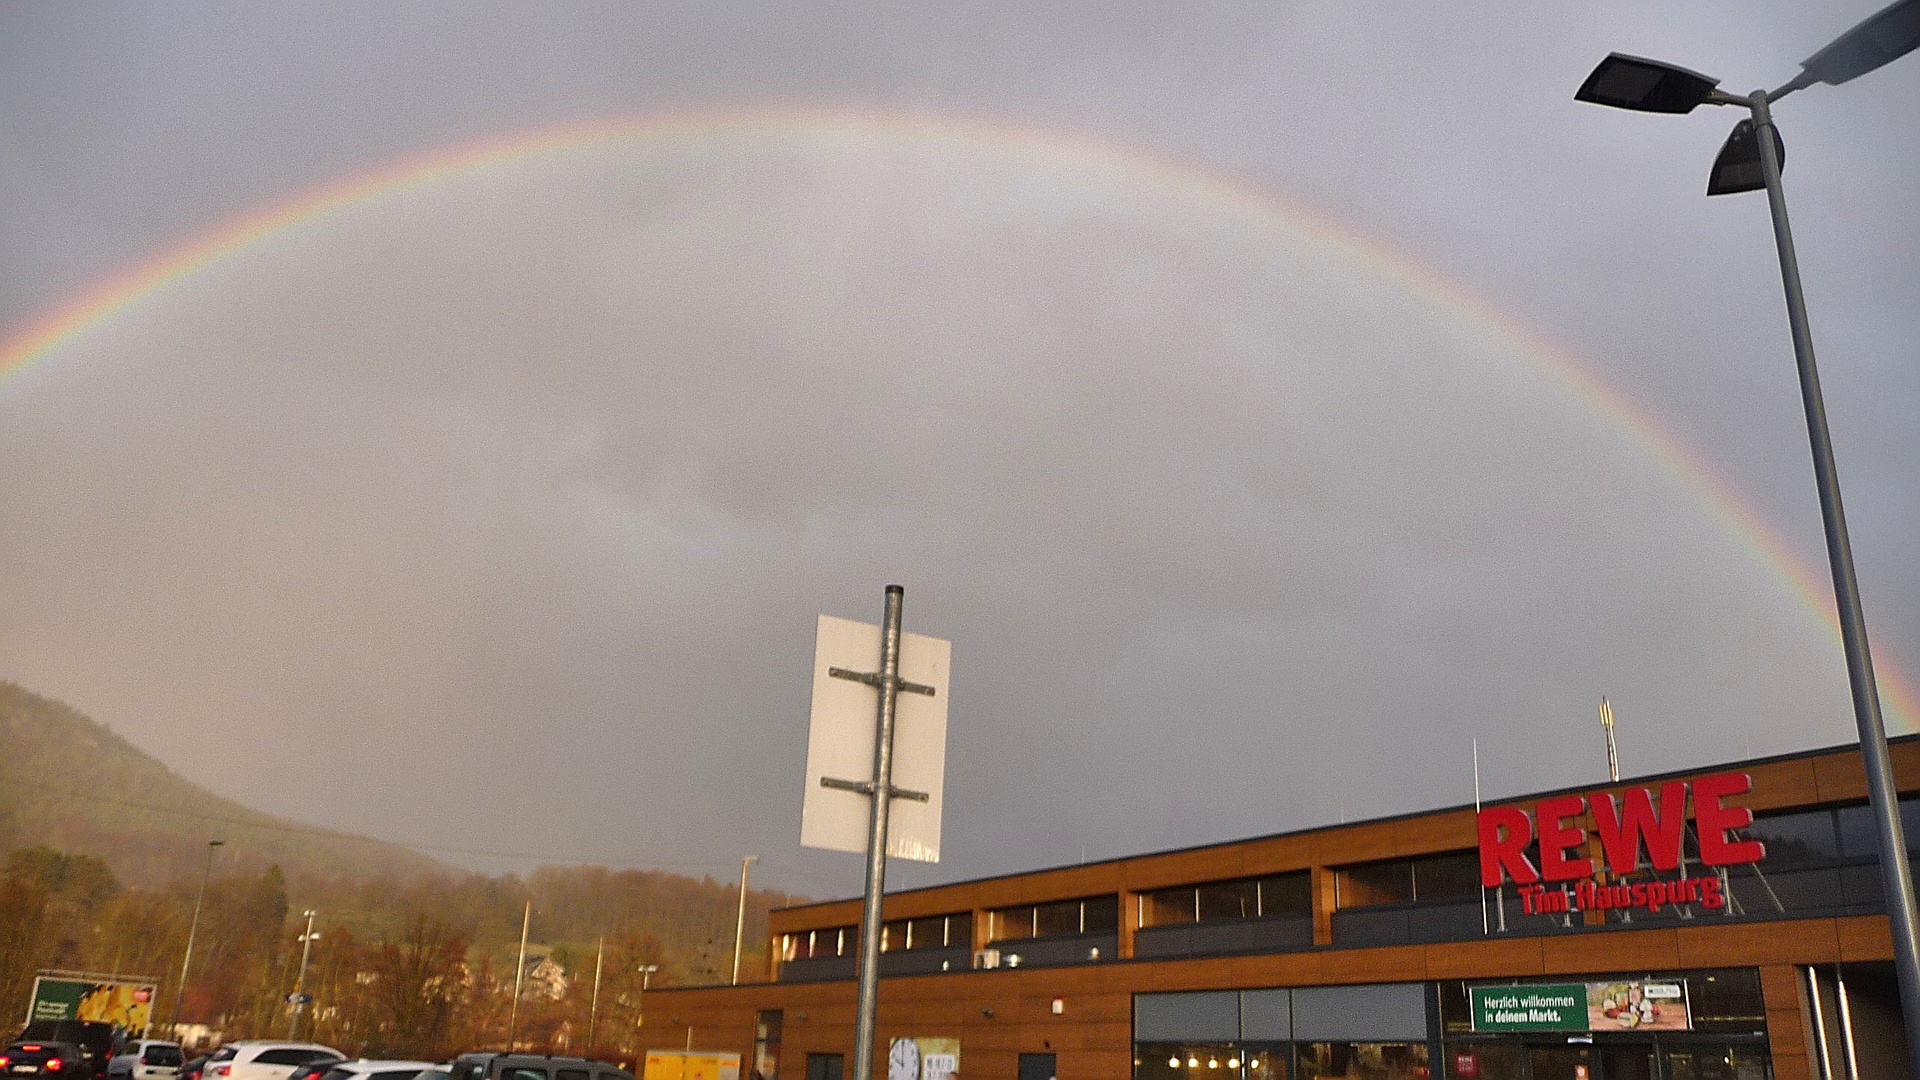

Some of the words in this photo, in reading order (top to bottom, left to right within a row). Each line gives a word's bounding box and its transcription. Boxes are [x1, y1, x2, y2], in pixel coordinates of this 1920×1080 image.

[1477, 773, 1765, 888] REWE
[1518, 884, 1569, 915] Tim
[1575, 876, 1724, 912] Hauspurg
[1484, 995, 1518, 1009] Herzlich
[1520, 994, 1575, 1009] willkommen
[1485, 1010, 1494, 1023] in
[1495, 1009, 1528, 1023] deinem
[1529, 1008, 1562, 1023] Markt.
